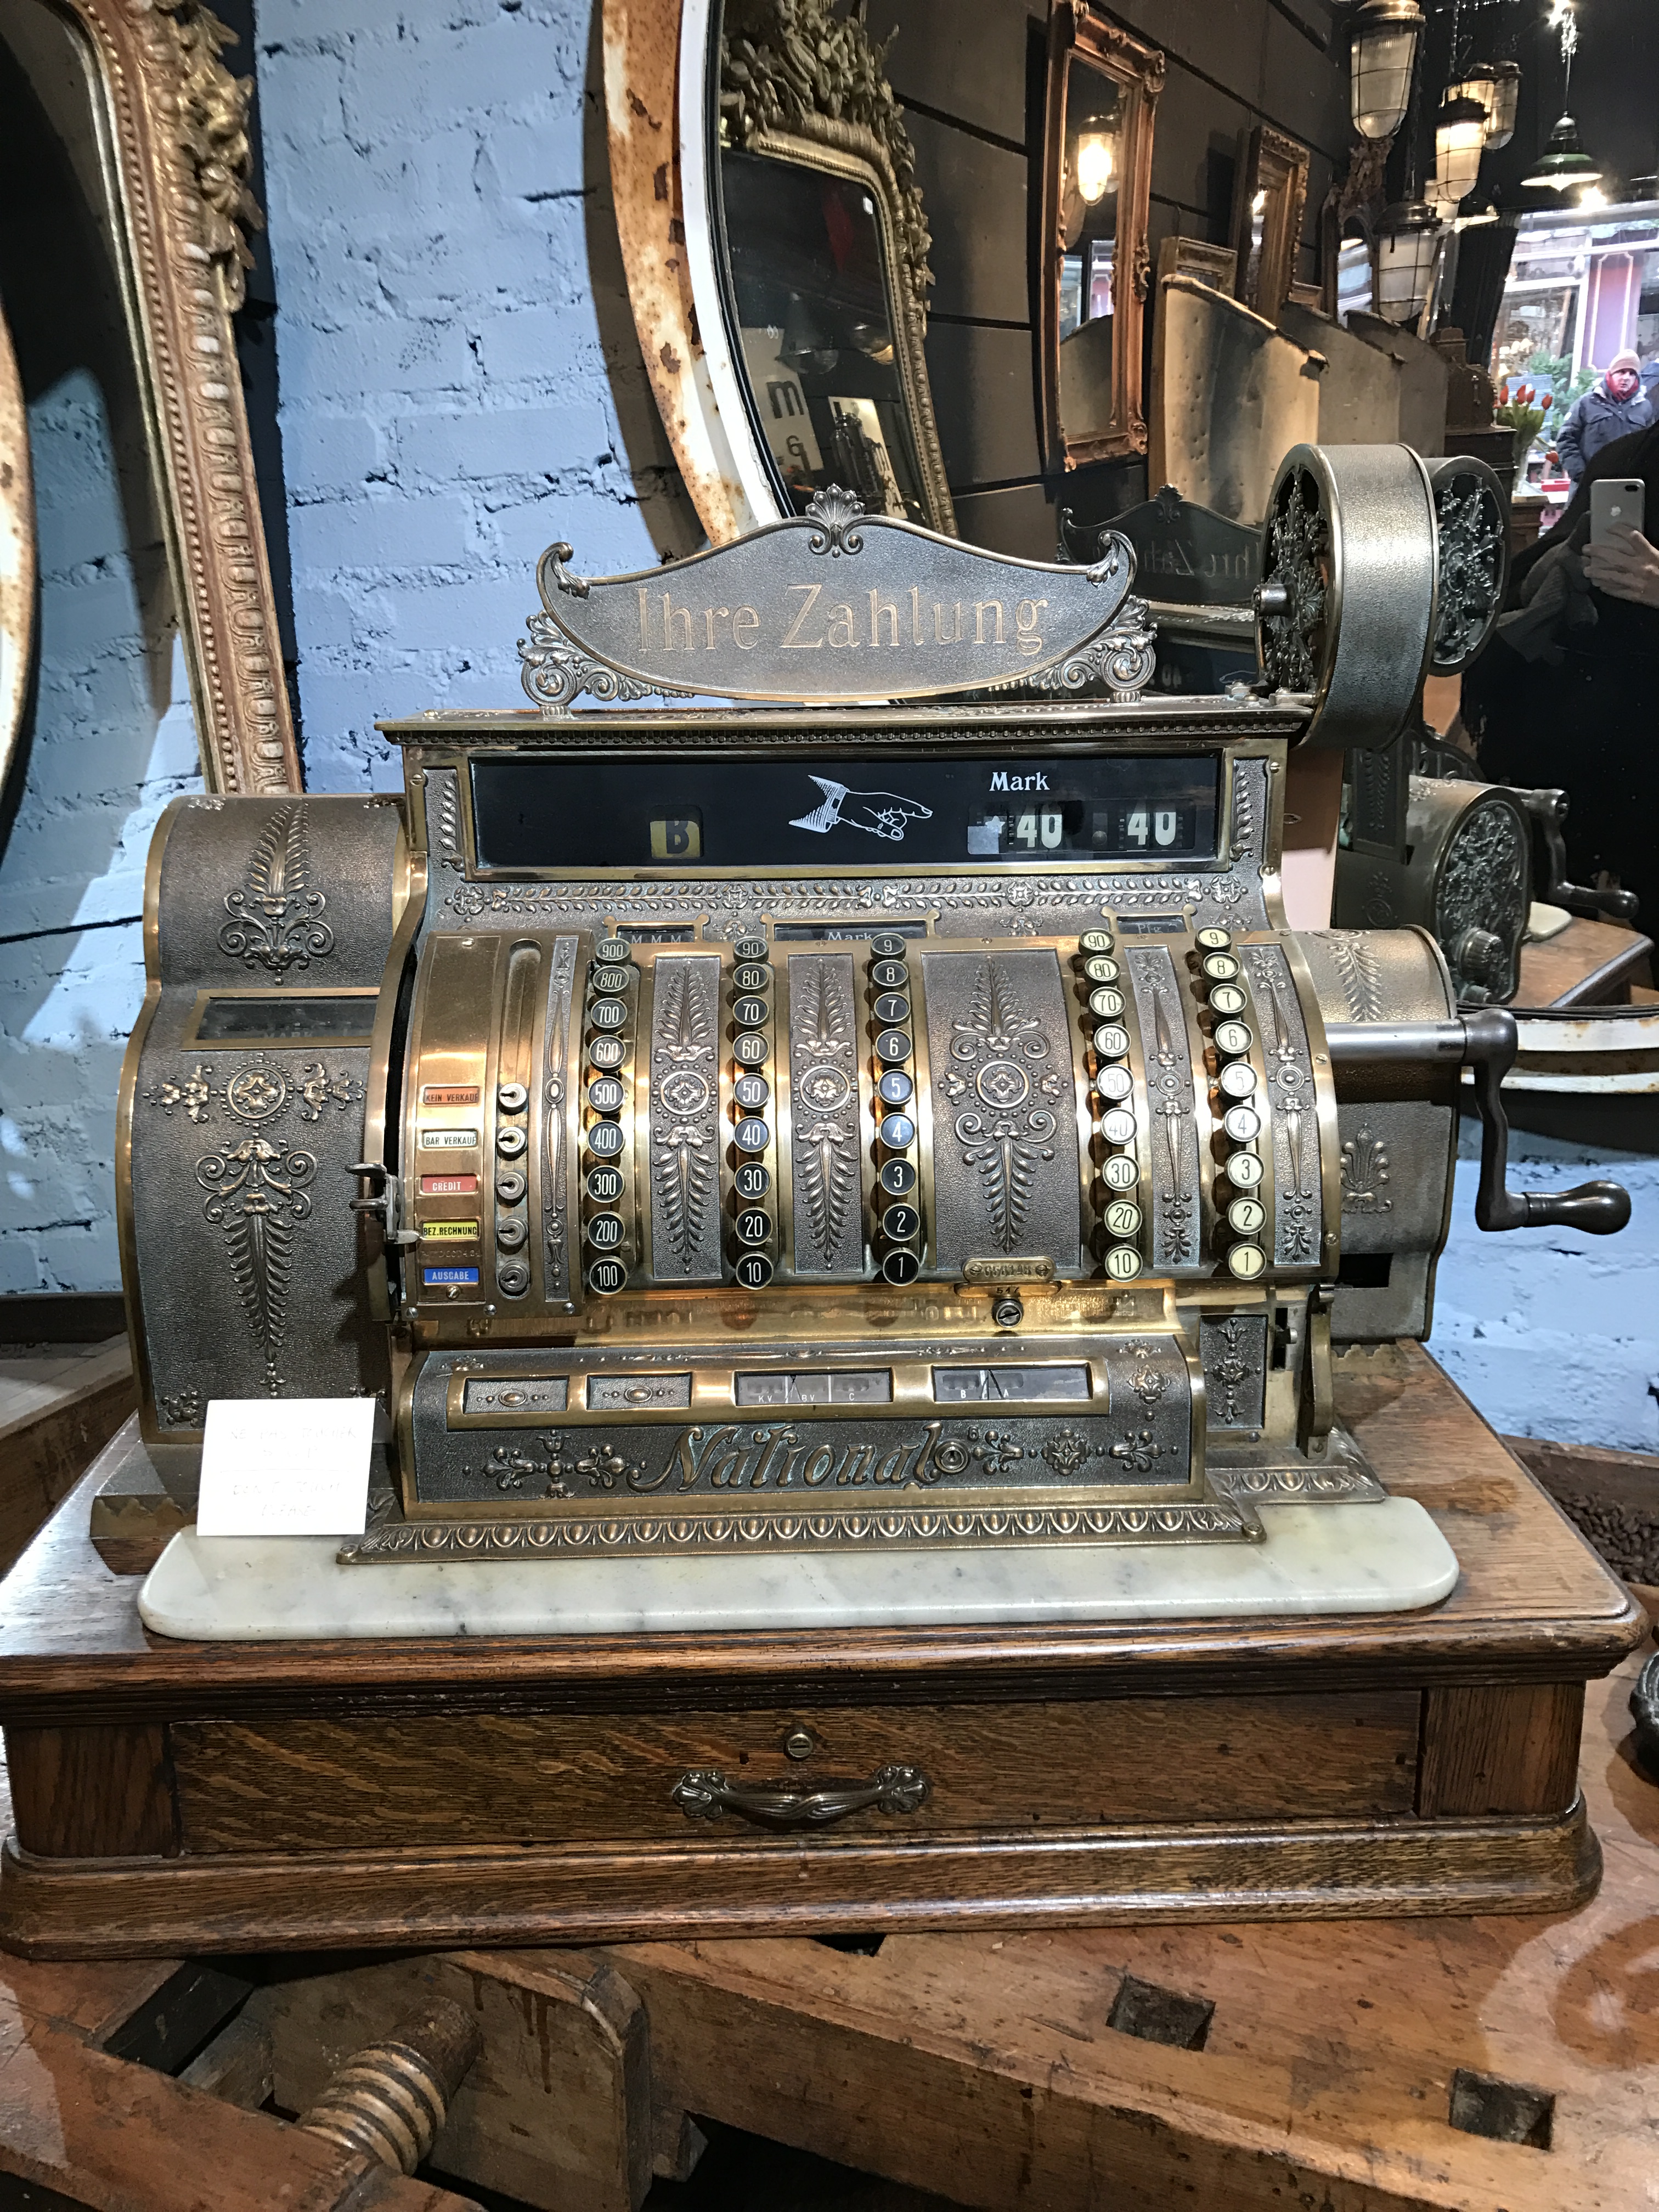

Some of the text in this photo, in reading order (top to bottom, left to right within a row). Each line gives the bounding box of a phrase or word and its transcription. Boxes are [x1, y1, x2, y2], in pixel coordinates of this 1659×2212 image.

[638, 583, 1050, 655] Ihre Zahlung
[989, 771, 1050, 792] Mark
[1017, 799, 1176, 848] 40 40
[884, 940, 892, 952] 9
[1089, 935, 1105, 948] 90
[1209, 933, 1218, 944] 9
[602, 945, 623, 957] 900
[743, 943, 759, 956] 90
[886, 967, 895, 981] 8
[1094, 963, 1110, 977] 80
[1216, 961, 1224, 974] 8
[600, 973, 622, 987] 800
[743, 972, 759, 985] 80
[888, 1001, 896, 1017] 7
[1099, 994, 1116, 1011] 70
[1223, 992, 1232, 1008] 7
[599, 1006, 619, 1023] 700
[743, 1004, 759, 1021] 70
[890, 1037, 899, 1056] 6
[1105, 1032, 1121, 1050] 60
[1229, 1030, 1237, 1047] 6
[596, 1043, 618, 1061] 600
[742, 1040, 759, 1058] 60
[891, 1079, 900, 1098] 5
[1108, 1074, 1124, 1092] 50
[1235, 1071, 1244, 1090] 5
[426, 1093, 478, 1102] KEIN VERKAUF
[595, 1084, 616, 1104] 500
[743, 1082, 760, 1102] 50
[892, 1122, 902, 1142] 4
[1109, 1117, 1127, 1136] 40
[1238, 1115, 1246, 1133] 4
[426, 1136, 476, 1145] BAR VERKAUF
[595, 1128, 616, 1148] 400
[743, 1125, 760, 1145] 40
[894, 1167, 903, 1187] 3
[1111, 1163, 1130, 1183] 30
[1242, 1160, 1250, 1180] 3
[432, 1181, 461, 1191] CREDIT
[594, 1175, 616, 1195] 300
[744, 1170, 761, 1191] 30
[896, 1212, 906, 1232] 2
[1113, 1208, 1132, 1228] 20
[1244, 1205, 1252, 1226] 2
[596, 1221, 617, 1242] 200
[745, 1216, 763, 1237] 20
[1114, 1253, 1131, 1273] 10
[432, 1271, 469, 1280] AUSGABE
[598, 1266, 617, 1286] 100
[747, 1262, 761, 1283] 10
[849, 1392, 855, 1401] C
[960, 1389, 966, 1399] B
[1003, 1389, 1009, 1398] A
[627, 1423, 943, 1492] National
